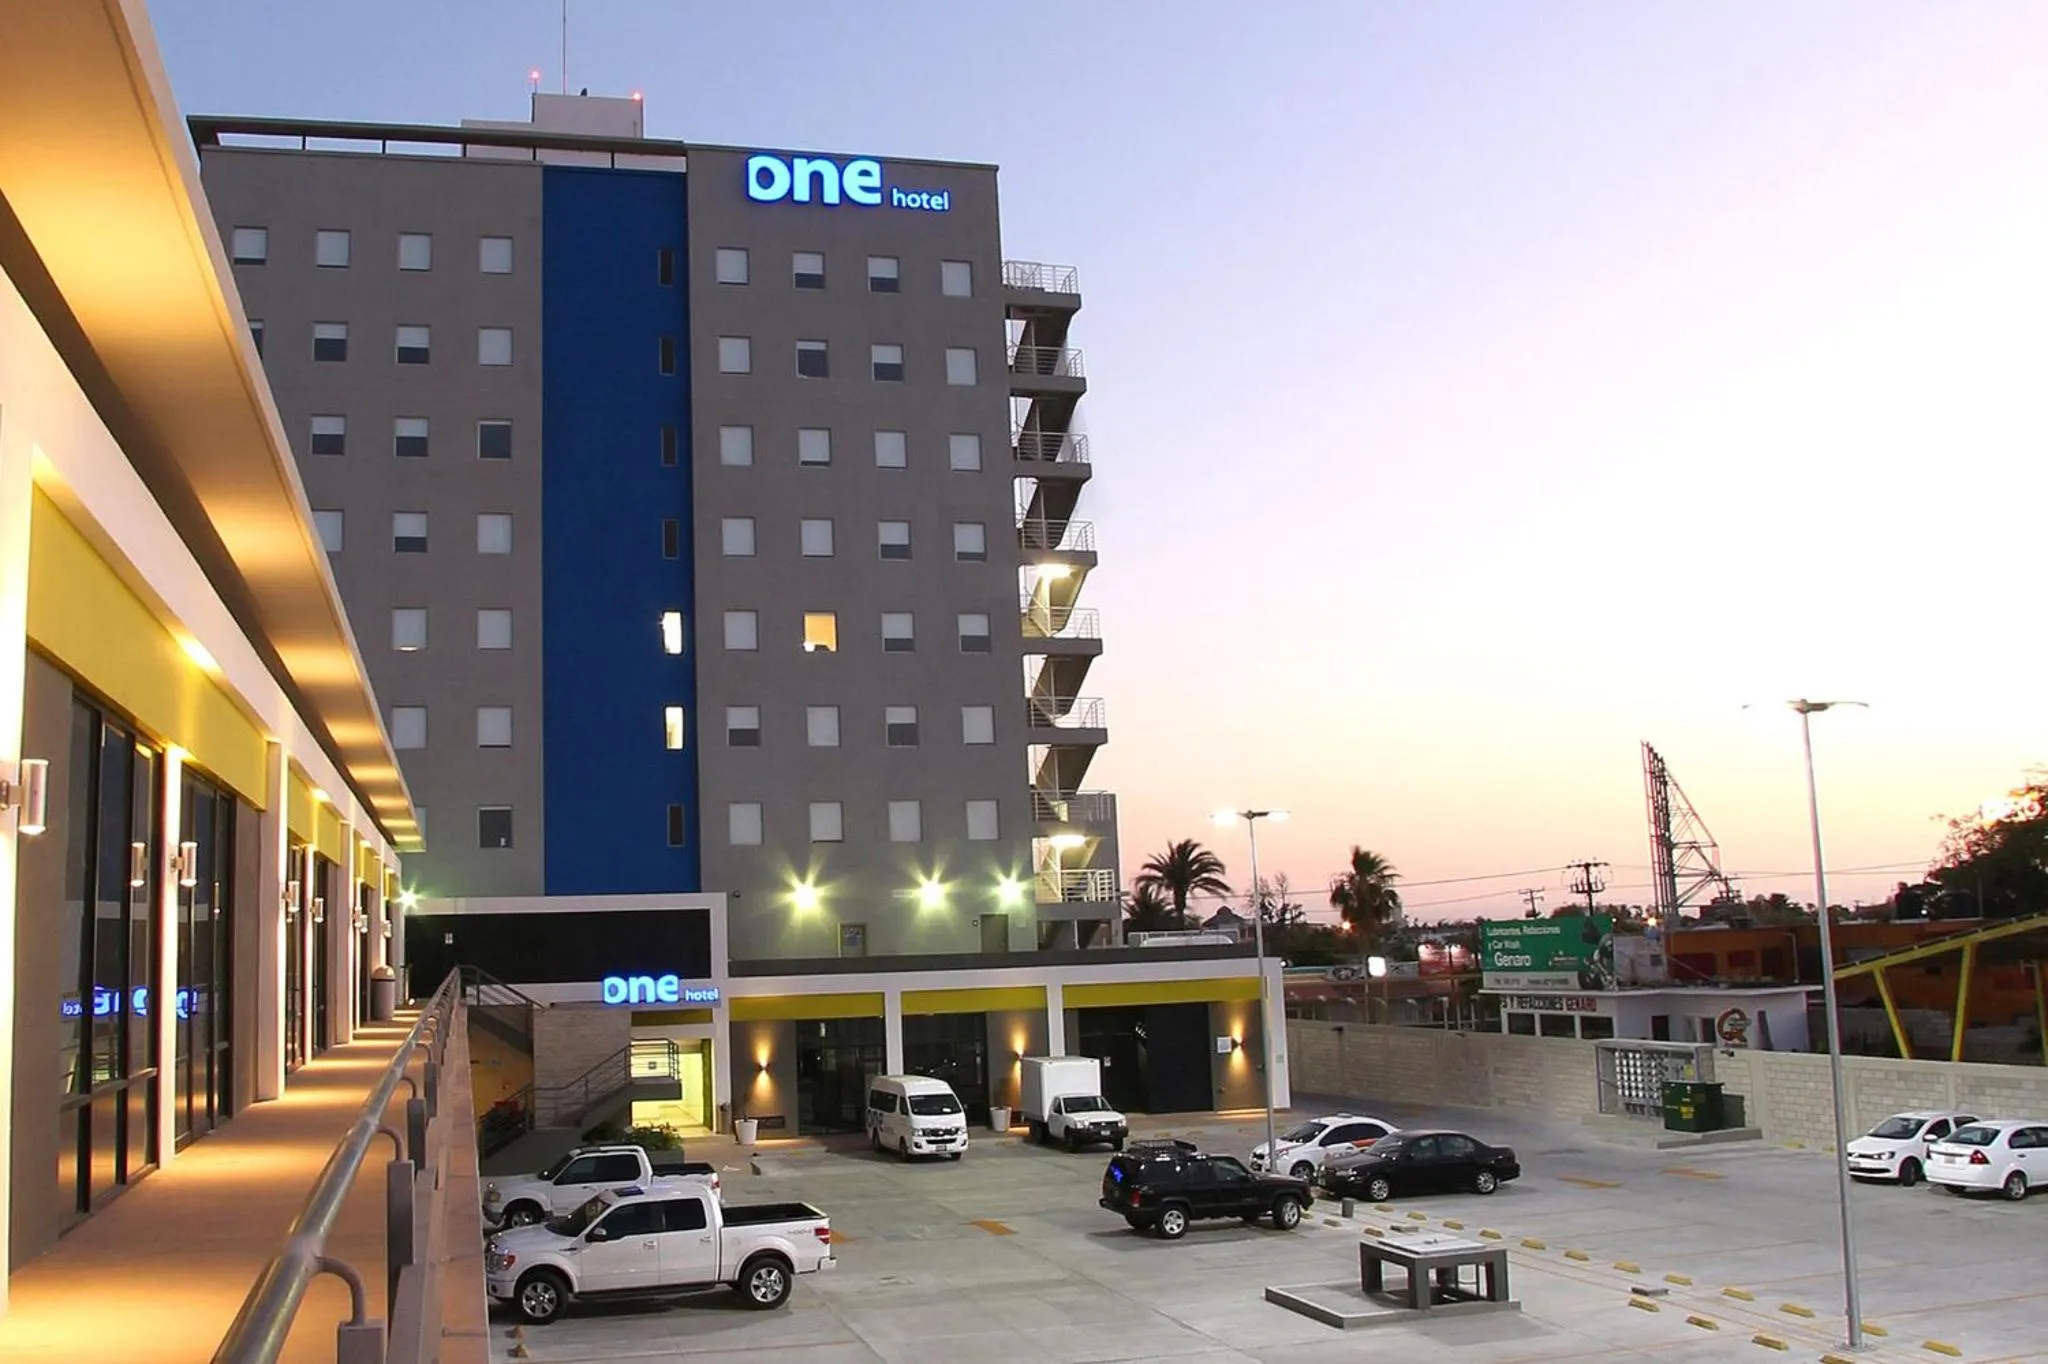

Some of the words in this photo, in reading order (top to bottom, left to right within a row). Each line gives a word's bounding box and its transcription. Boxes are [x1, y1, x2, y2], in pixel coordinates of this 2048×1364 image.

[747, 154, 882, 205] one
[892, 187, 949, 210] hotel
[1494, 951, 1532, 967] Genaro
[603, 974, 679, 1004] one
[685, 988, 719, 1001] hotel
